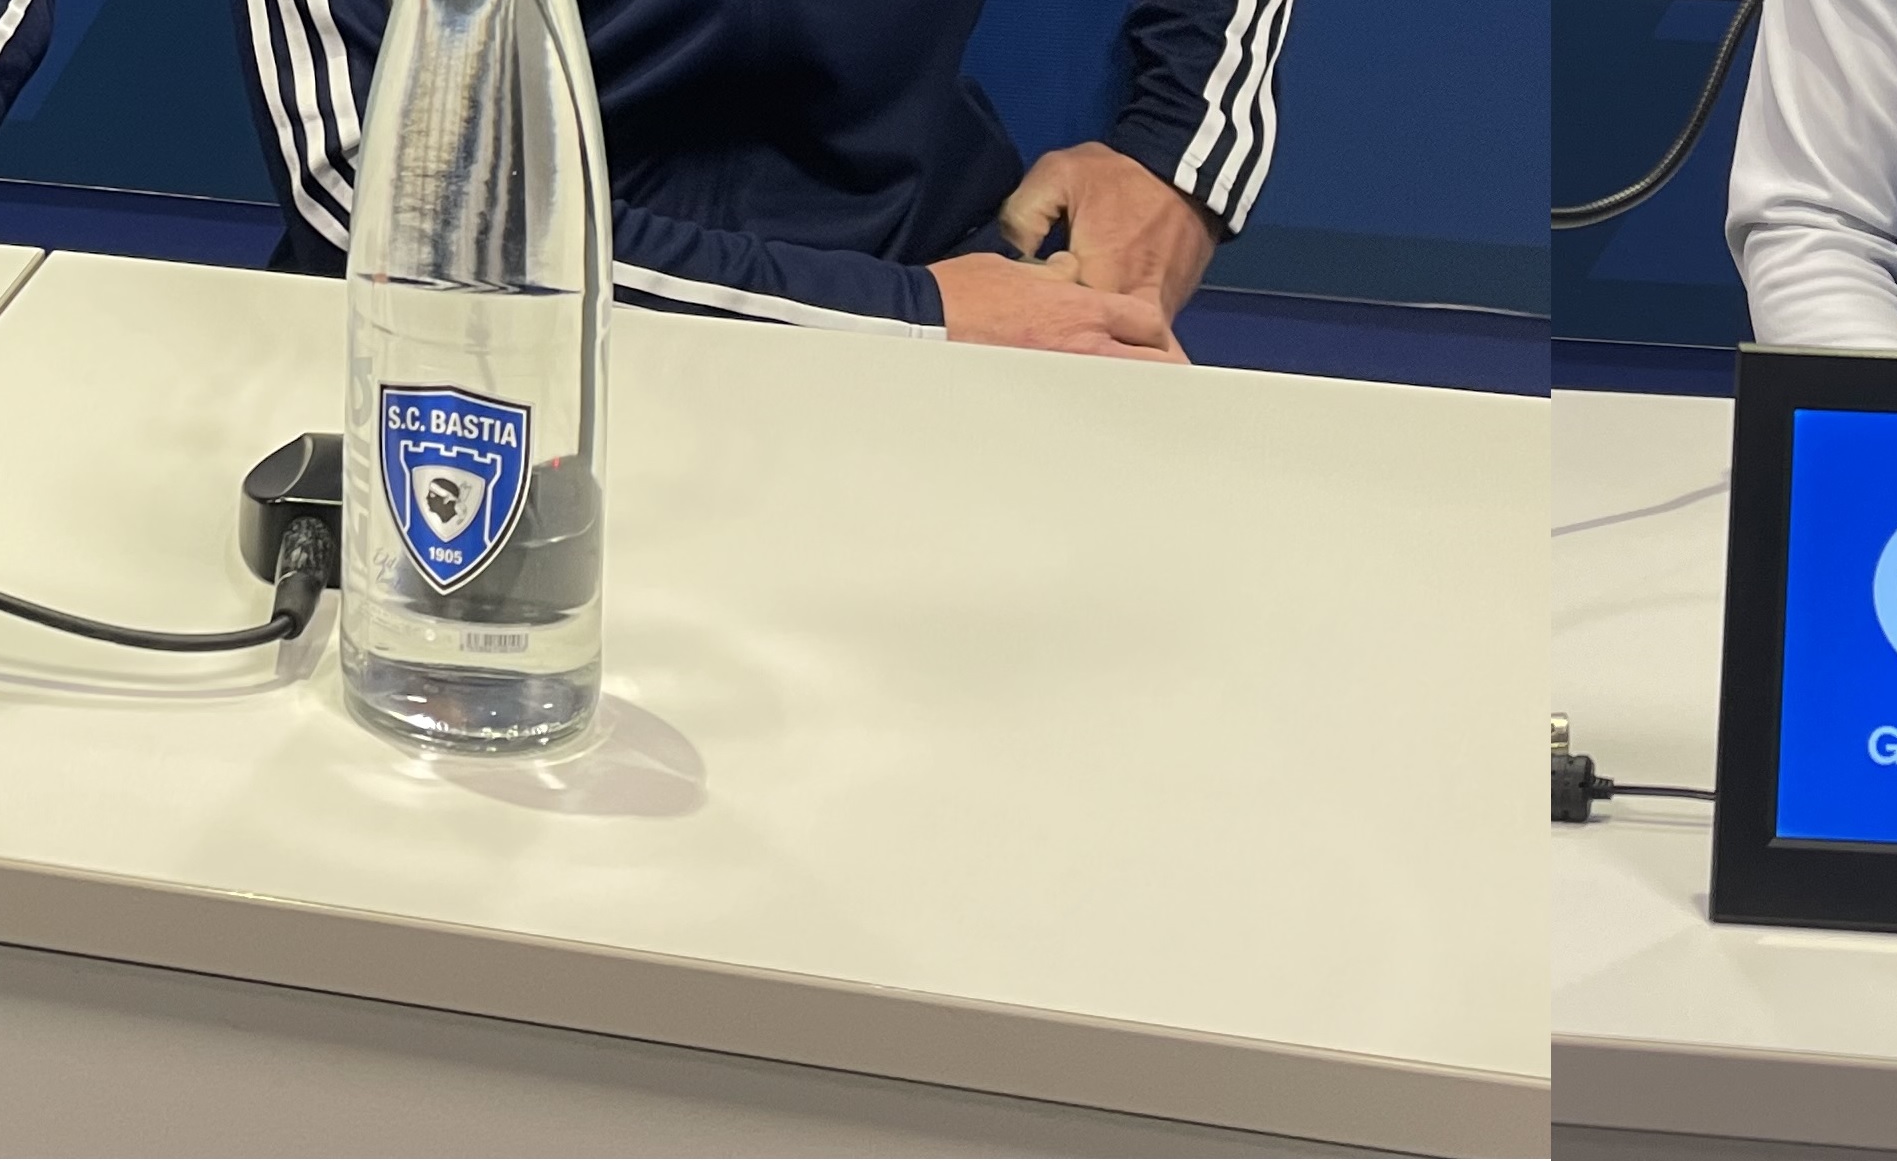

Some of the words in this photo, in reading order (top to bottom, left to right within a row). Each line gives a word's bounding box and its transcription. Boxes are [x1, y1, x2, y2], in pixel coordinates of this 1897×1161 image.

[387, 405, 425, 433] S.C.
[430, 408, 518, 448] BASTIA
[427, 545, 464, 565] 1905
